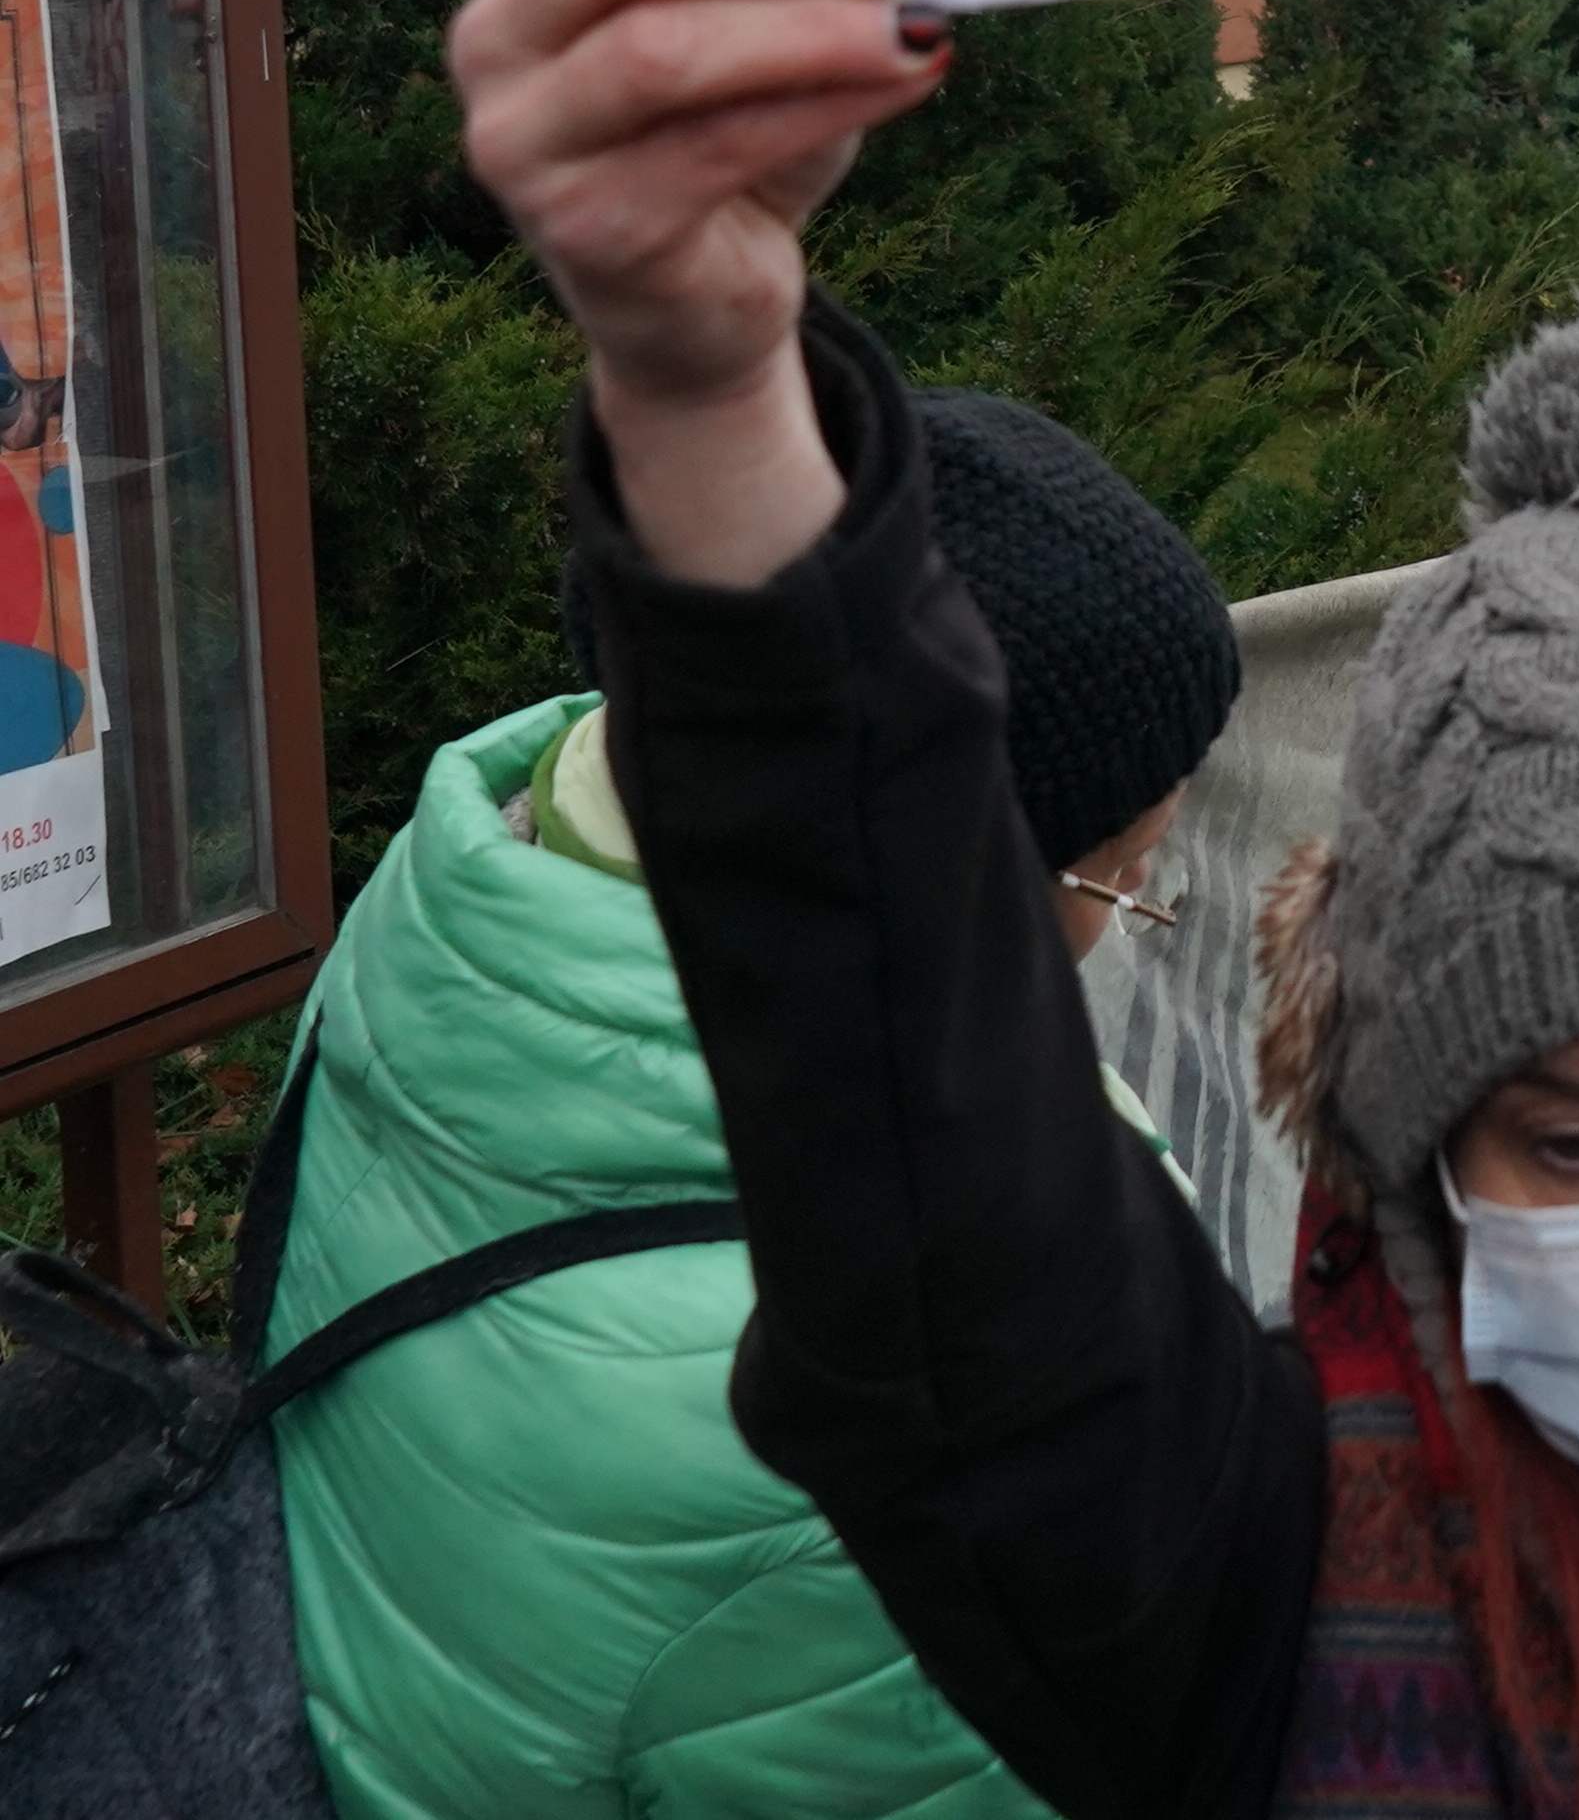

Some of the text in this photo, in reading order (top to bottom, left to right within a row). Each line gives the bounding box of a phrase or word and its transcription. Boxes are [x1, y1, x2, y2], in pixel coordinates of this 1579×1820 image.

[1, 817, 53, 854] 18.30
[53, 852, 71, 874] 32
[75, 845, 97, 868] 03
